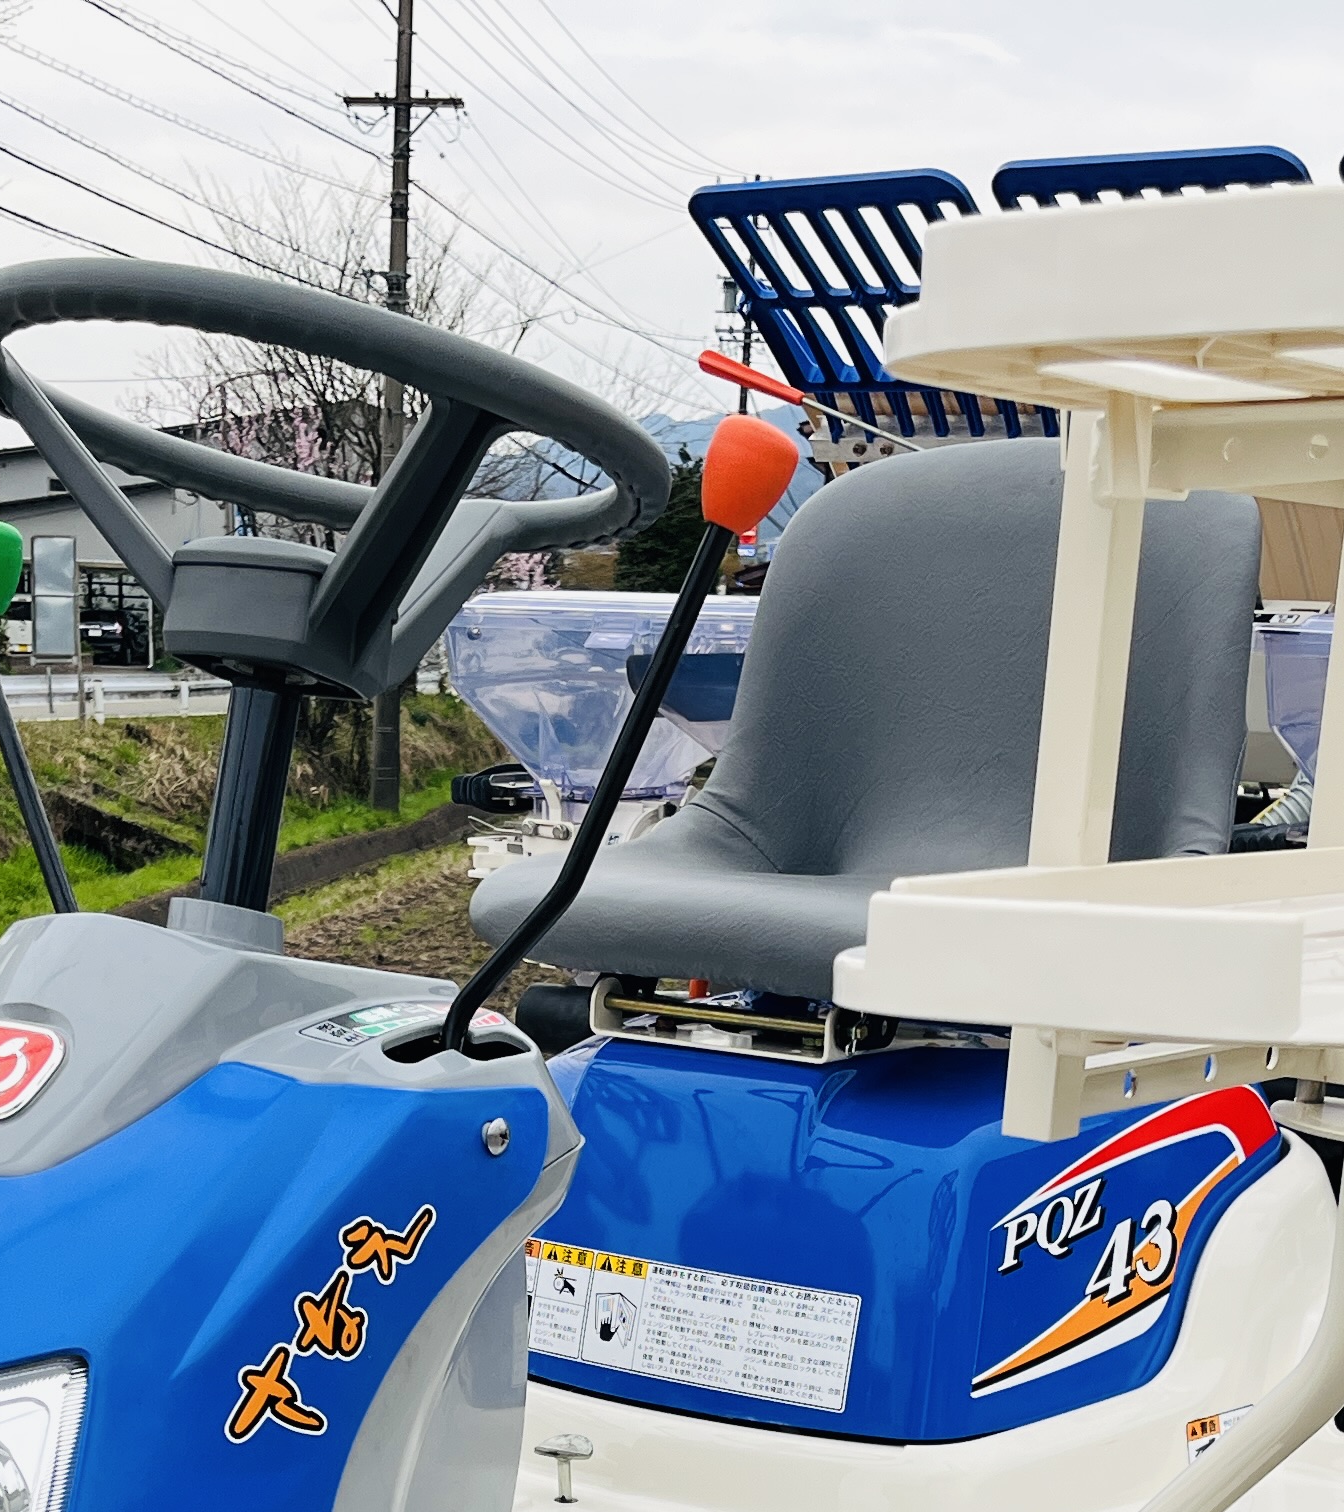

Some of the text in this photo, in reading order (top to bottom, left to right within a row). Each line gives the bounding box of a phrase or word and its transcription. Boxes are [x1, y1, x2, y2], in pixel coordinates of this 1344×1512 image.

[998, 1178, 1180, 1307] PQZ 43
[562, 1249, 588, 1265] 注意
[616, 1258, 643, 1276] 注意
